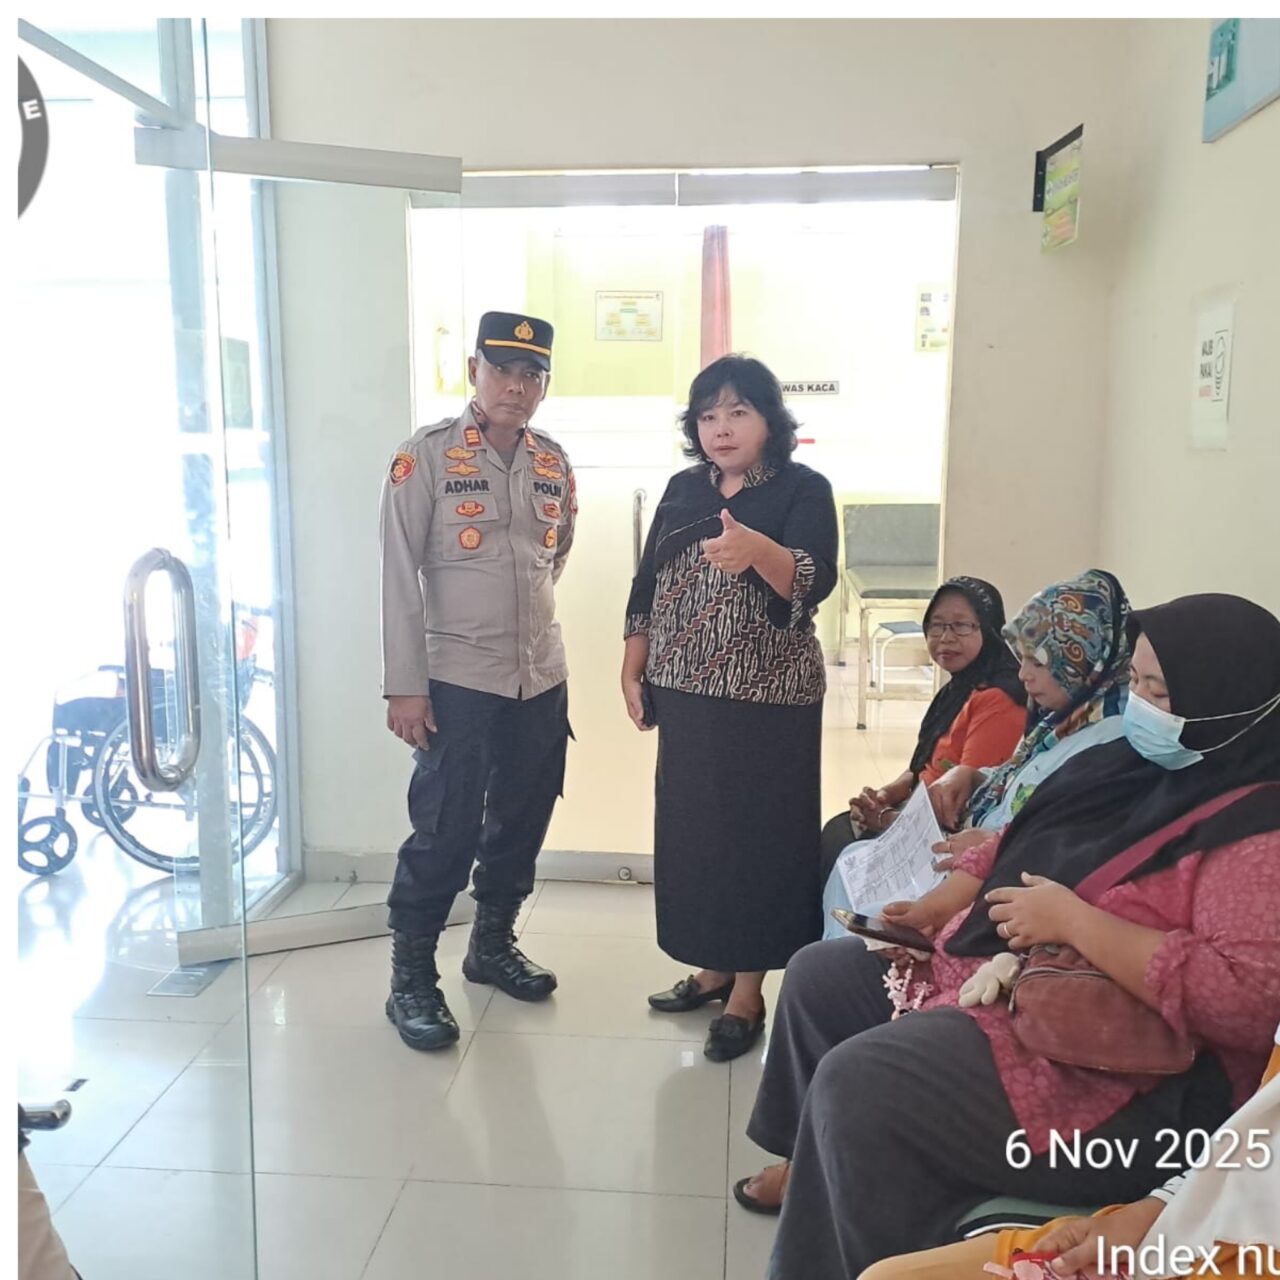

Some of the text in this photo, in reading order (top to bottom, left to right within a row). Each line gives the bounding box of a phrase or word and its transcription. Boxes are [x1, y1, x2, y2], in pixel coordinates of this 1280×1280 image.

[782, 383, 835, 392] WAS KACA
[444, 479, 489, 494] ADHAR
